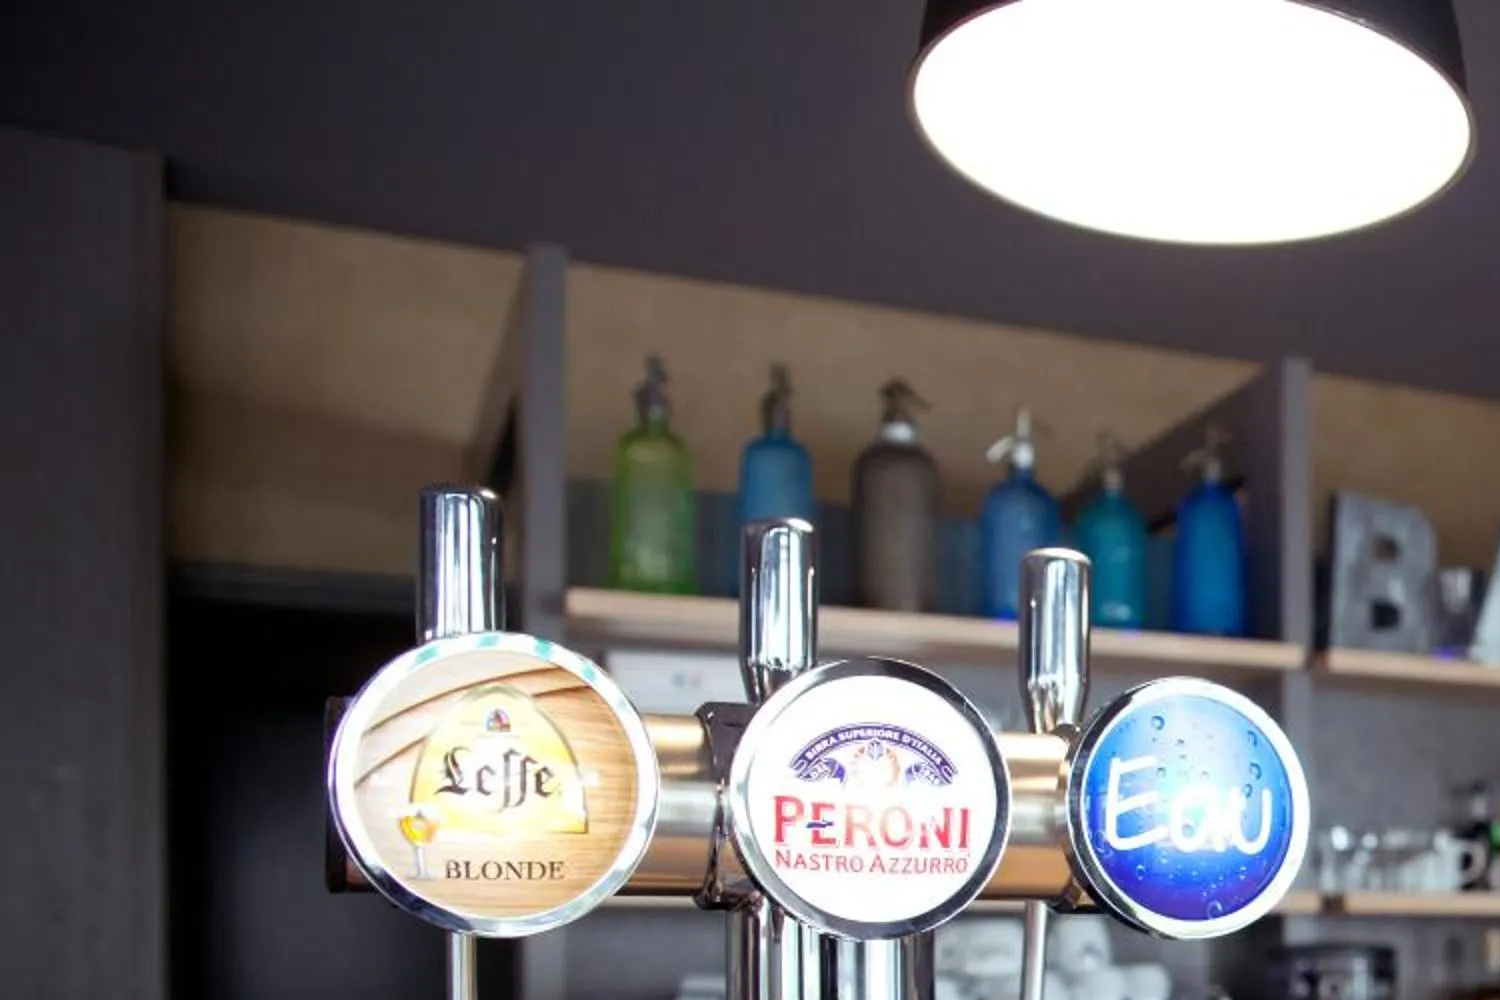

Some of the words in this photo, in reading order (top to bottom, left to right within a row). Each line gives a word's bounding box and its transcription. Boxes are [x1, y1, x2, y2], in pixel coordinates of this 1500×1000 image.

[804, 735, 837, 761] BIRRA
[838, 728, 901, 742] SUPERIORE
[434, 746, 556, 813] Leffe
[773, 795, 972, 850] PERONI
[1105, 754, 1273, 855] Eau
[446, 859, 566, 881] BLONDE
[775, 849, 864, 873] NASTRO
[869, 854, 969, 875] AZZURRO
